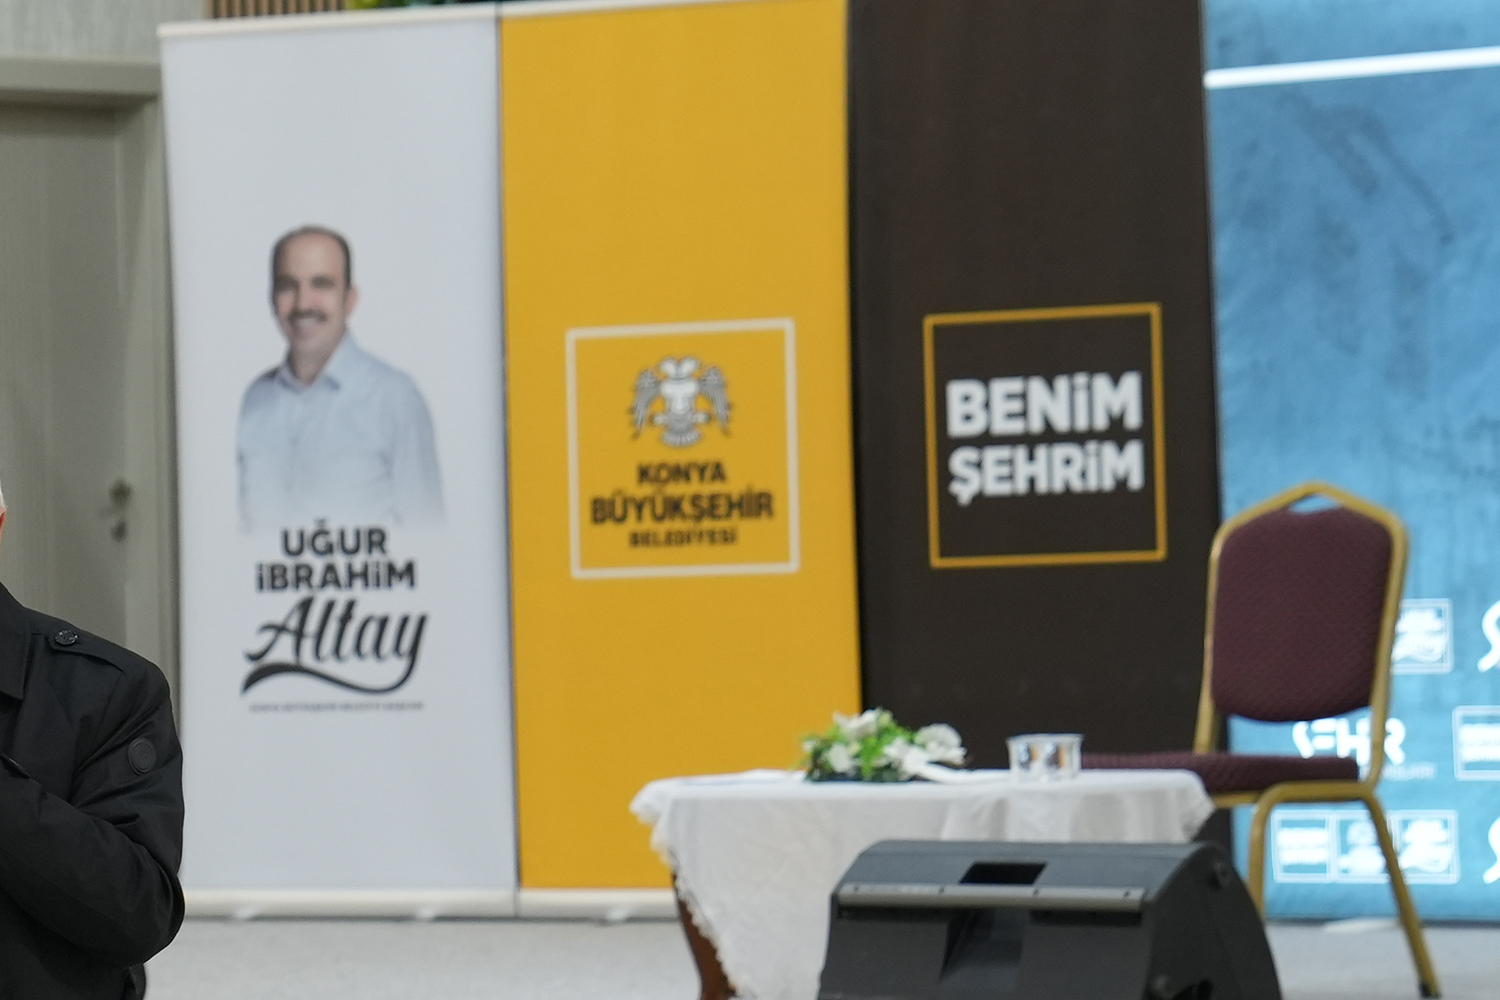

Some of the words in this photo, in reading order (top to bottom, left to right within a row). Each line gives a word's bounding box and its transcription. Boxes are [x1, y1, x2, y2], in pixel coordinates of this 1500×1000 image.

[946, 371, 1143, 438] BENİM
[637, 461, 727, 486] KONYA
[948, 440, 1145, 506] ŞEHRİM
[591, 487, 774, 525] BÜYÜKŞEHİR
[281, 519, 388, 556] UĞUR
[255, 560, 417, 592] İBRAHİM
[240, 596, 428, 696] Altay
